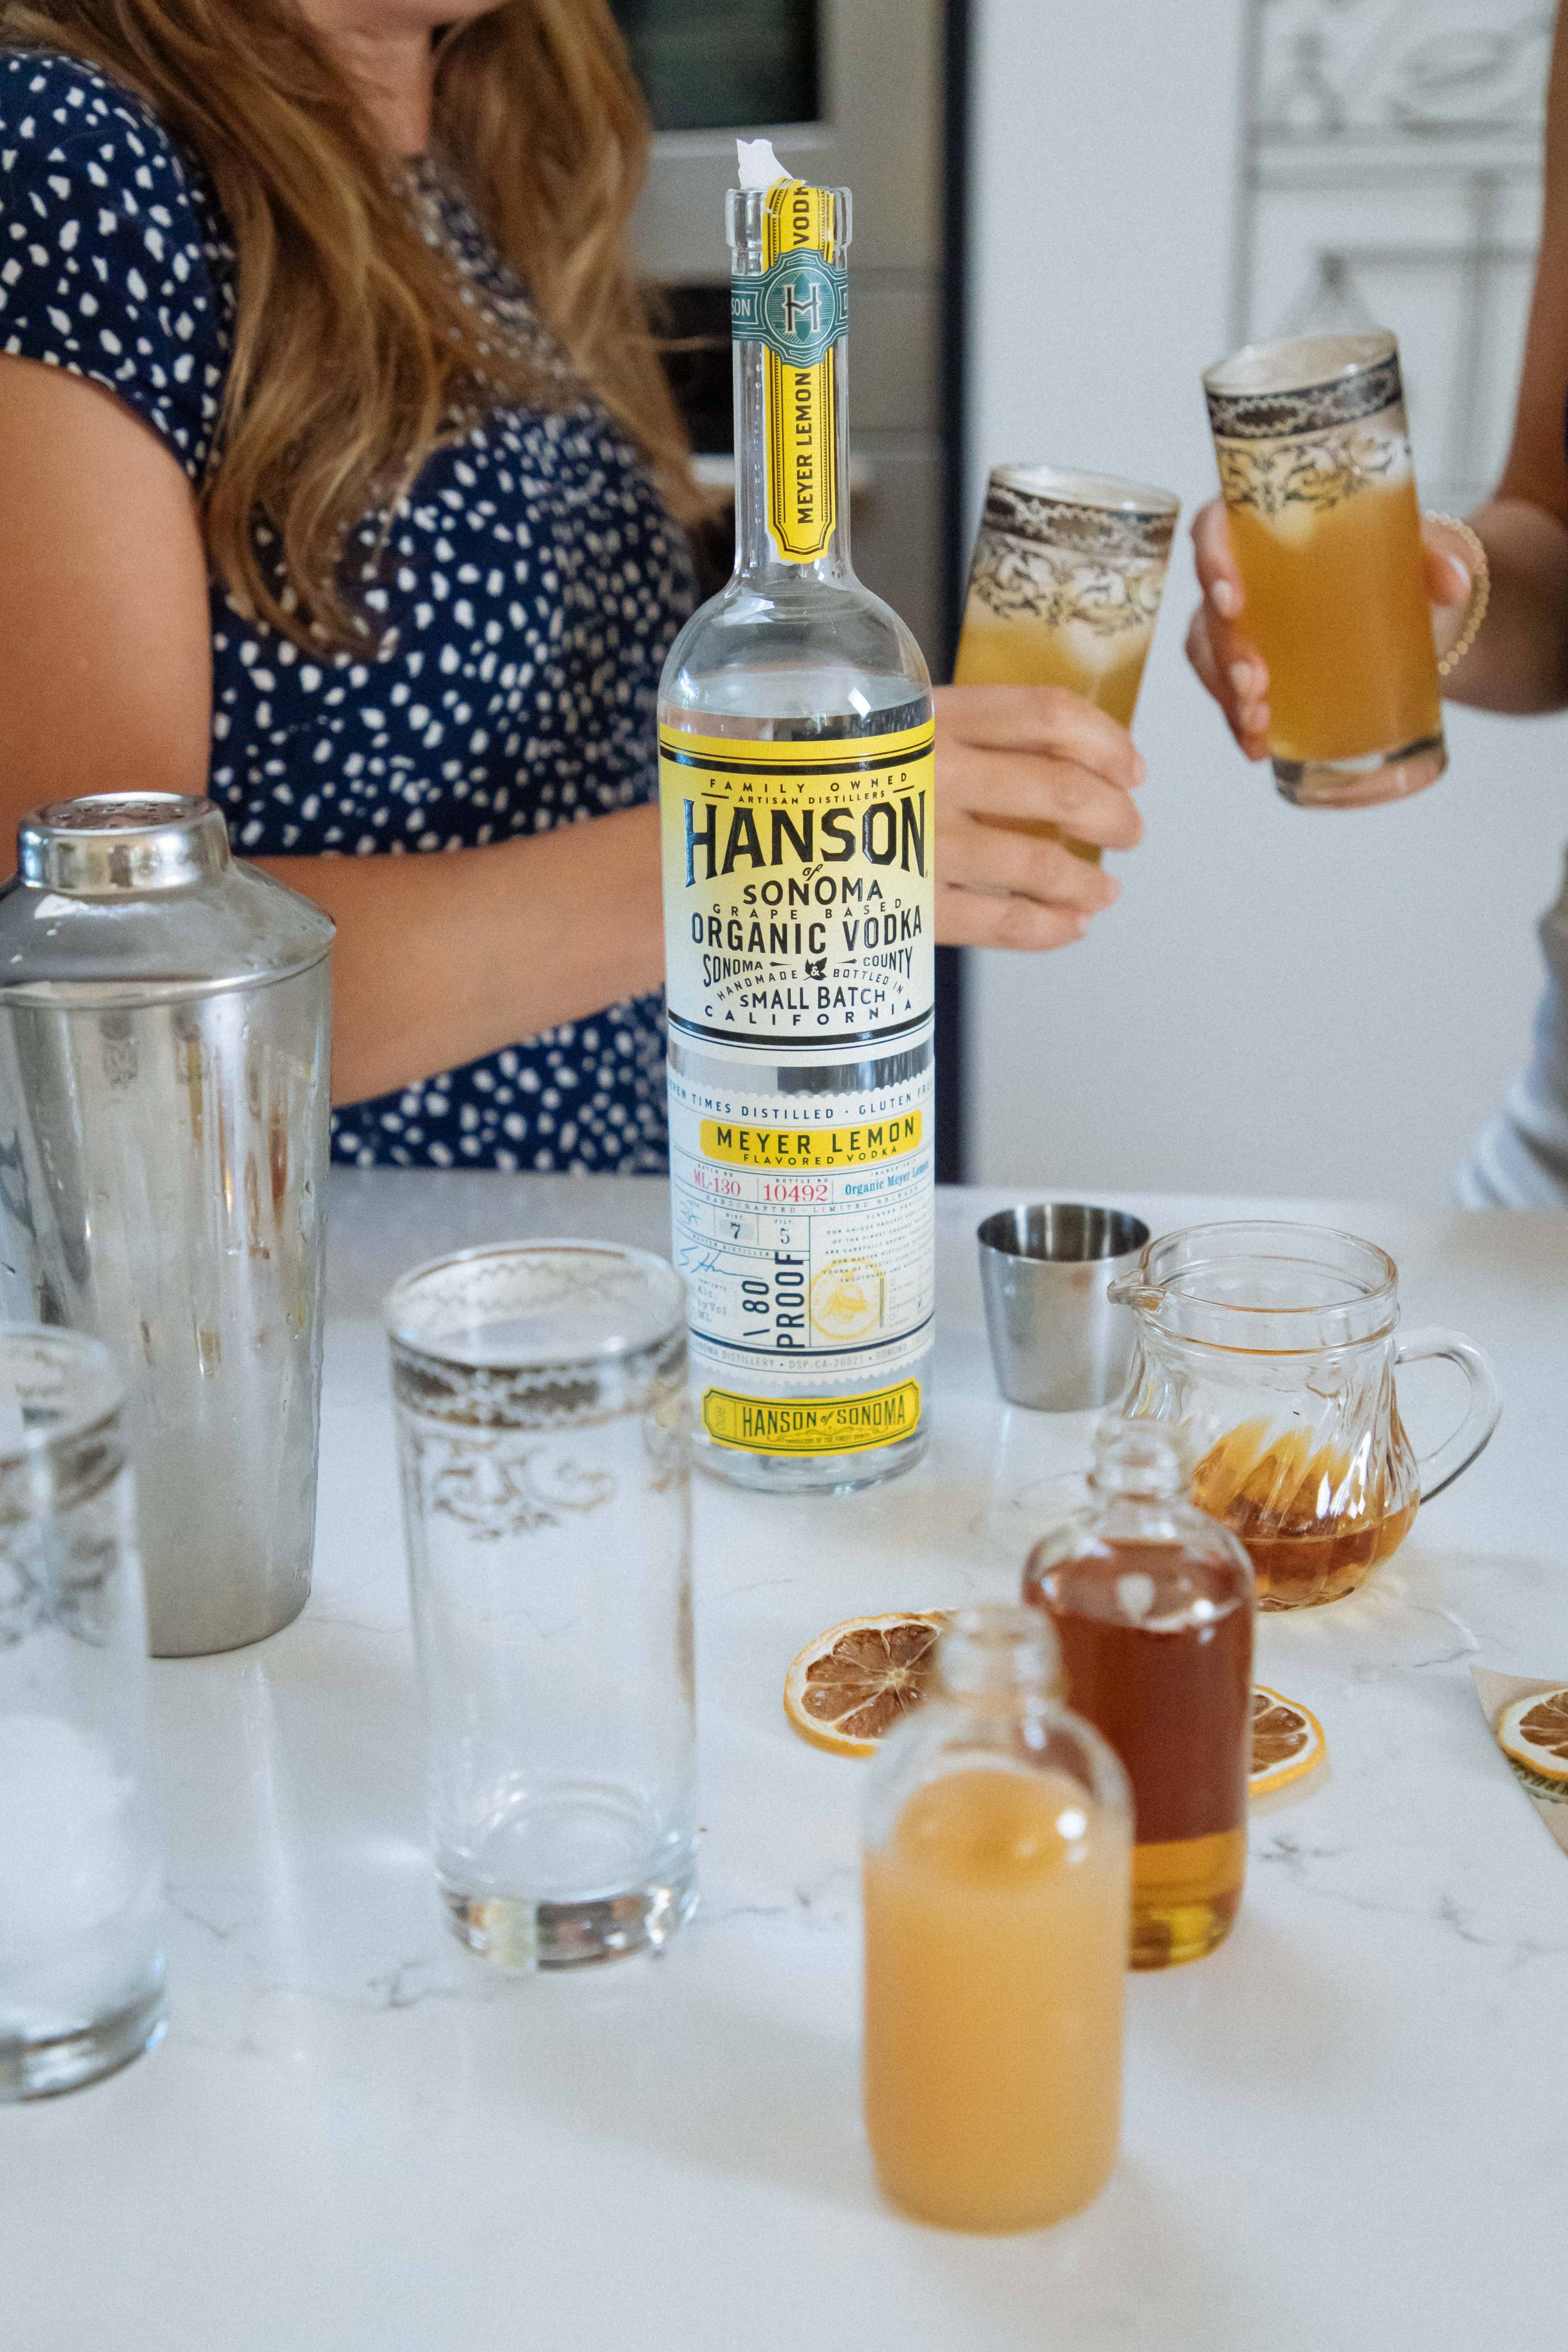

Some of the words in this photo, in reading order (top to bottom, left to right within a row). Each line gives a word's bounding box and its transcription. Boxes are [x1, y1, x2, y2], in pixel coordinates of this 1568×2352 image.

[782, 282, 822, 334] H
[795, 373, 812, 446] LEMON
[797, 454, 813, 523] MEYER
[710, 778, 805, 794] FAMILY
[830, 773, 907, 792] OWNED
[738, 795, 798, 805] ARTISAN
[808, 790, 885, 804] DISTILLERS
[684, 790, 926, 888] HANSON
[802, 863, 823, 881] of
[743, 876, 883, 906] SONOMA
[713, 904, 798, 920] GRAPE
[825, 898, 901, 919] BASED
[692, 912, 826, 955] ORGANIC
[842, 905, 922, 951] VODKA
[703, 953, 763, 987] SONOMA
[863, 946, 912, 979] COUNTY
[717, 970, 798, 1001] HANDMADE
[833, 969, 889, 985] BOTTLED
[893, 981, 904, 994] IN
[740, 987, 809, 1010] SMALL
[818, 986, 885, 1009] BATCH
[705, 998, 912, 1026] CALIFORNIA
[692, 1094, 730, 1113] TIMES
[742, 1106, 833, 1119] DISTILLED
[859, 1093, 911, 1115] GLUTEN
[718, 1127, 811, 1154] MEYER
[832, 1116, 914, 1153] LEMON
[744, 1154, 834, 1165] FLAVORED
[847, 1146, 897, 1162] VODKA
[694, 1168, 741, 1197] ML-130
[763, 1184, 828, 1202] 10492
[845, 1179, 884, 1196] Organic
[888, 1172, 910, 1187] Meyer
[813, 1202, 869, 1213] LIMITED
[730, 1221, 741, 1239] 7
[780, 1228, 790, 1244] 5
[742, 1281, 770, 1314] 80
[775, 1252, 805, 1348] PROOF
[723, 1350, 775, 1367] DISTILLERY
[742, 1406, 817, 1438] HANSON
[821, 1411, 834, 1425] of
[837, 1394, 906, 1426] SONOMA
